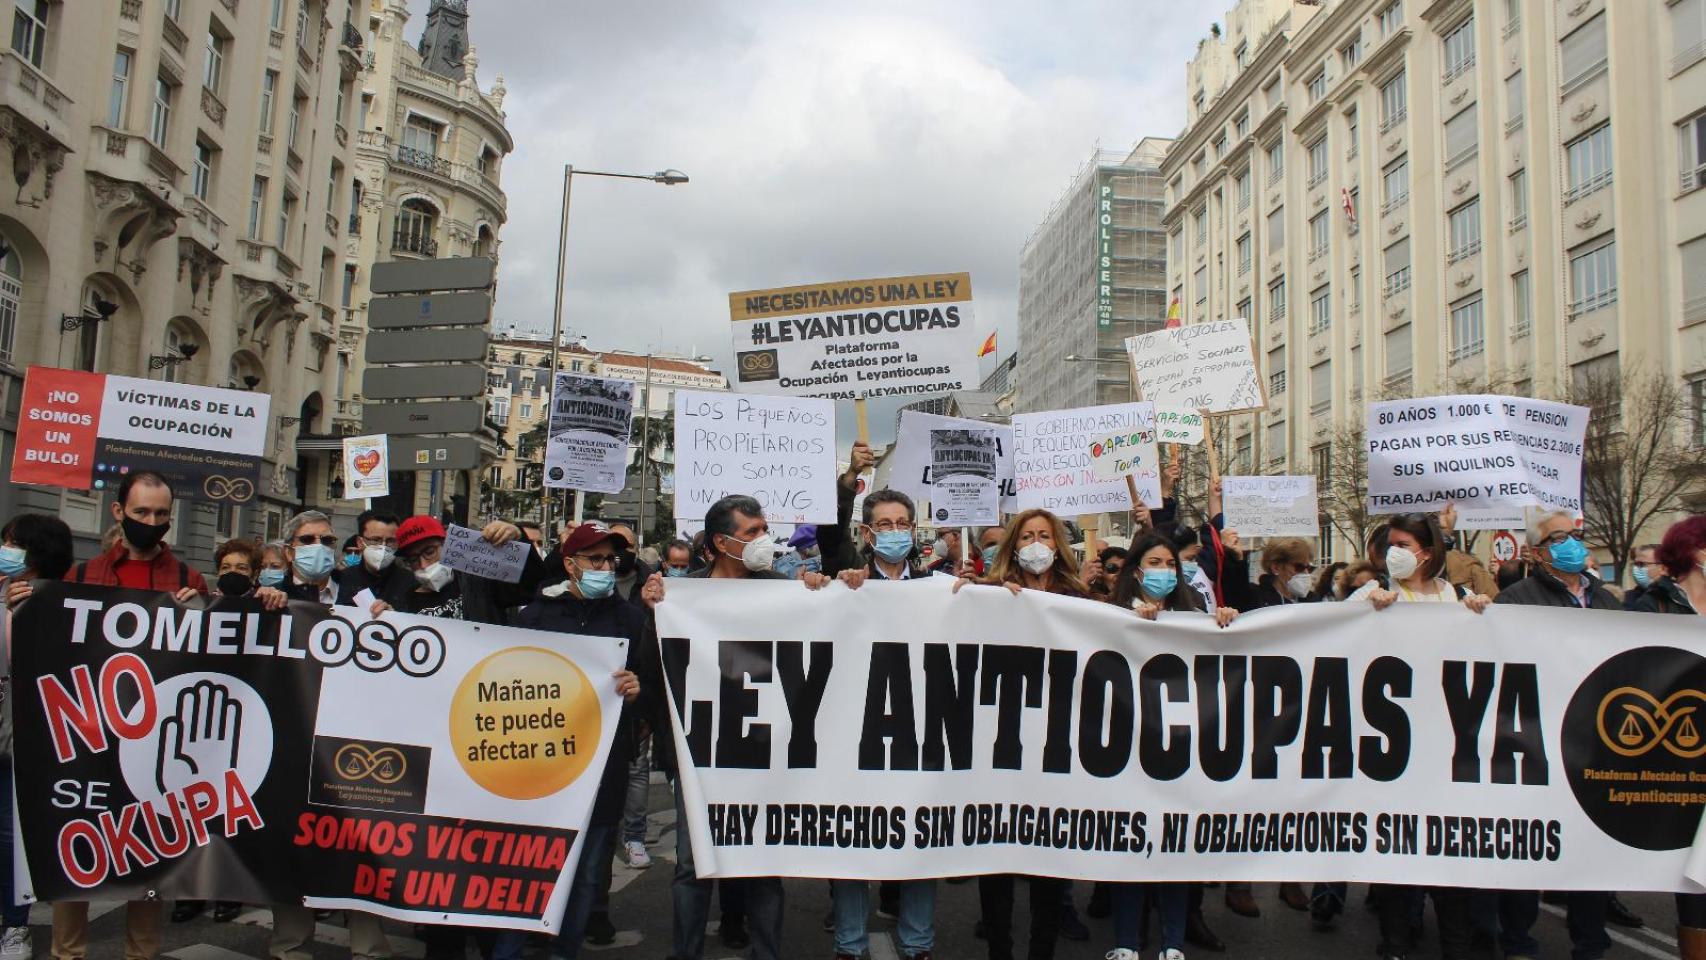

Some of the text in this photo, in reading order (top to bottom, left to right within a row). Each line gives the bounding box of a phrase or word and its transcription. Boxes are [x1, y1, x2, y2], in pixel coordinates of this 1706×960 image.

[1101, 186, 1111, 296] PROLISER
[746, 280, 959, 314] NECESITAMOS UNA LEY
[751, 306, 960, 345] #LEYANTIOCUPAS
[825, 340, 900, 355] Plataforma
[810, 352, 918, 371] Afectados por la
[779, 372, 848, 388] Ocupación
[857, 365, 950, 383] Leyantiocupas
[48, 390, 79, 404] ¡NO
[861, 382, 962, 399] @LEYANTIOCUPAS
[1183, 393, 1214, 408] ONG
[118, 389, 256, 418] VÍCTIMAS DE LA
[685, 397, 724, 420] LOS
[1379, 403, 1568, 427] 80 AÑOS 1.000 € DE PENSIÓN
[29, 408, 92, 425] SOMOS
[128, 415, 232, 439] OCUPACIÓN
[1014, 410, 1153, 438] EL GOBIERNO ARRUINA
[45, 430, 71, 444] UN
[694, 428, 824, 454] PROPIETARIOS
[1089, 430, 1153, 458] TOCAPELOTAS
[1162, 429, 1190, 439] TOUR
[1370, 437, 1421, 452] PAGAN
[1427, 433, 1457, 448] POR
[1461, 432, 1491, 446] SUS
[1551, 439, 1573, 454] 2.300
[1575, 444, 1581, 455] €
[25, 448, 79, 466] BULO!
[1014, 440, 1030, 456] AL
[693, 461, 812, 480] NO SOMOS
[1114, 456, 1141, 473] TOUR
[1393, 463, 1425, 477] SUS
[1434, 455, 1515, 474] INQUILINOS
[1531, 462, 1559, 480] PAGAR
[1053, 473, 1075, 487] CON
[1043, 496, 1061, 509] LEY
[1065, 490, 1128, 507] ANTIOCUPAS
[1371, 486, 1479, 506] TRABAJANDO
[1484, 485, 1495, 498] Y
[450, 527, 469, 538] LOS
[63, 598, 446, 678] TOMELLOSO
[478, 679, 561, 703] Mañana
[37, 653, 158, 763] NO
[661, 638, 1549, 786] LEY ANTIOCUPAS YA
[475, 709, 566, 736] te puede
[467, 736, 576, 763] afectar a ti
[1584, 768, 1638, 782] Plataforma
[1640, 770, 1686, 782] Afectados
[51, 779, 110, 812] SE
[1609, 788, 1706, 806] Leyantiocupas
[56, 769, 265, 889] OKUPA
[294, 812, 416, 857] SOMOS
[708, 804, 1561, 862] HAY DERECHOS SIN OBLIGACIONES, NI OBLIGACIONES SIN DERECHOS
[353, 864, 396, 900] DE
[403, 871, 456, 908] UN
